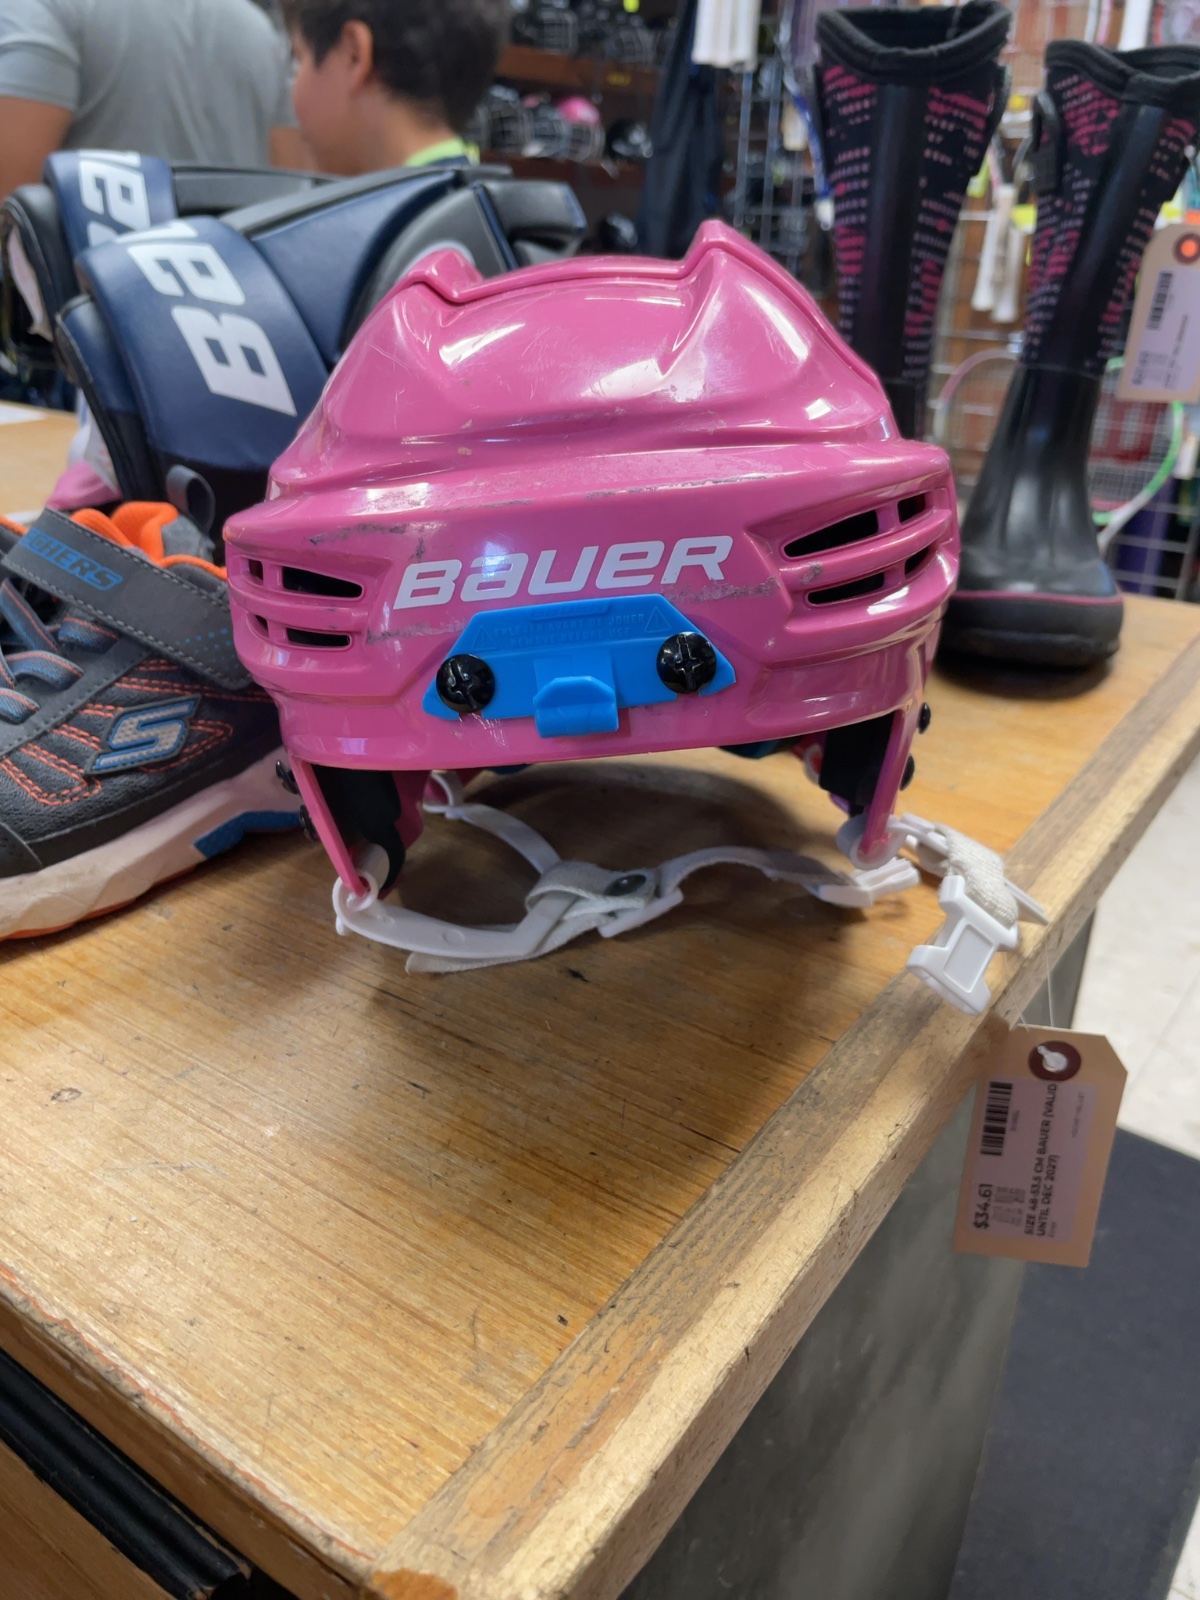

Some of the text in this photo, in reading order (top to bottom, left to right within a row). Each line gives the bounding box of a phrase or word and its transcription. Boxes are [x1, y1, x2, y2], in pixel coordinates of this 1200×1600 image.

[609, 613, 645, 626] JOUER
[608, 627, 631, 639] USE
[1042, 1083, 1057, 1118] (VALID
[1036, 1119, 1051, 1155] BAUER
[1034, 1156, 1045, 1174] CM
[1041, 1184, 1053, 1204] DEC
[973, 1183, 993, 1230] $34.61
[1024, 1213, 1036, 1235] SIZE
[1036, 1207, 1049, 1236] UNTIL
